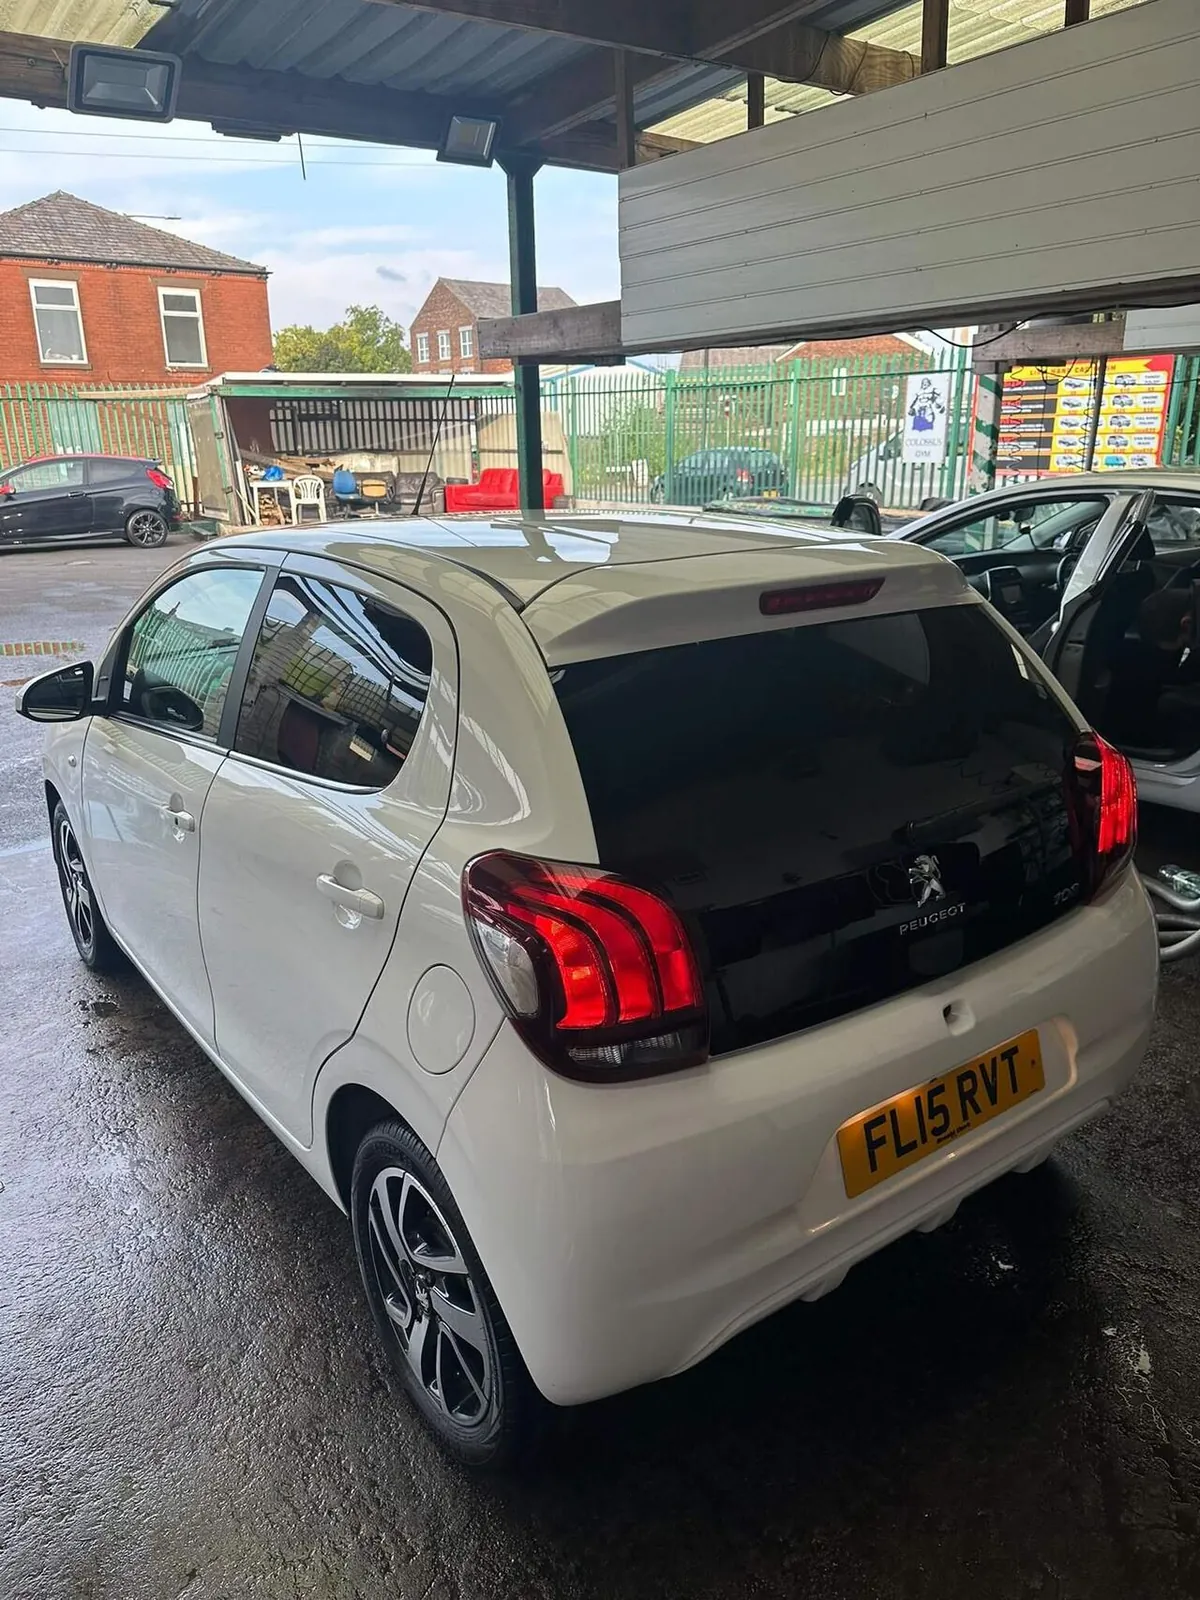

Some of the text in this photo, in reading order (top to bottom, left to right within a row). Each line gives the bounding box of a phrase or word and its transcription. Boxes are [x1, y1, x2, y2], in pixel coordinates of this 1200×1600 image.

[905, 438, 943, 448] COLOSSUS
[915, 450, 931, 458] GYM
[899, 902, 966, 936] PEUGEOT
[863, 1045, 1020, 1173] FL15 RVT
